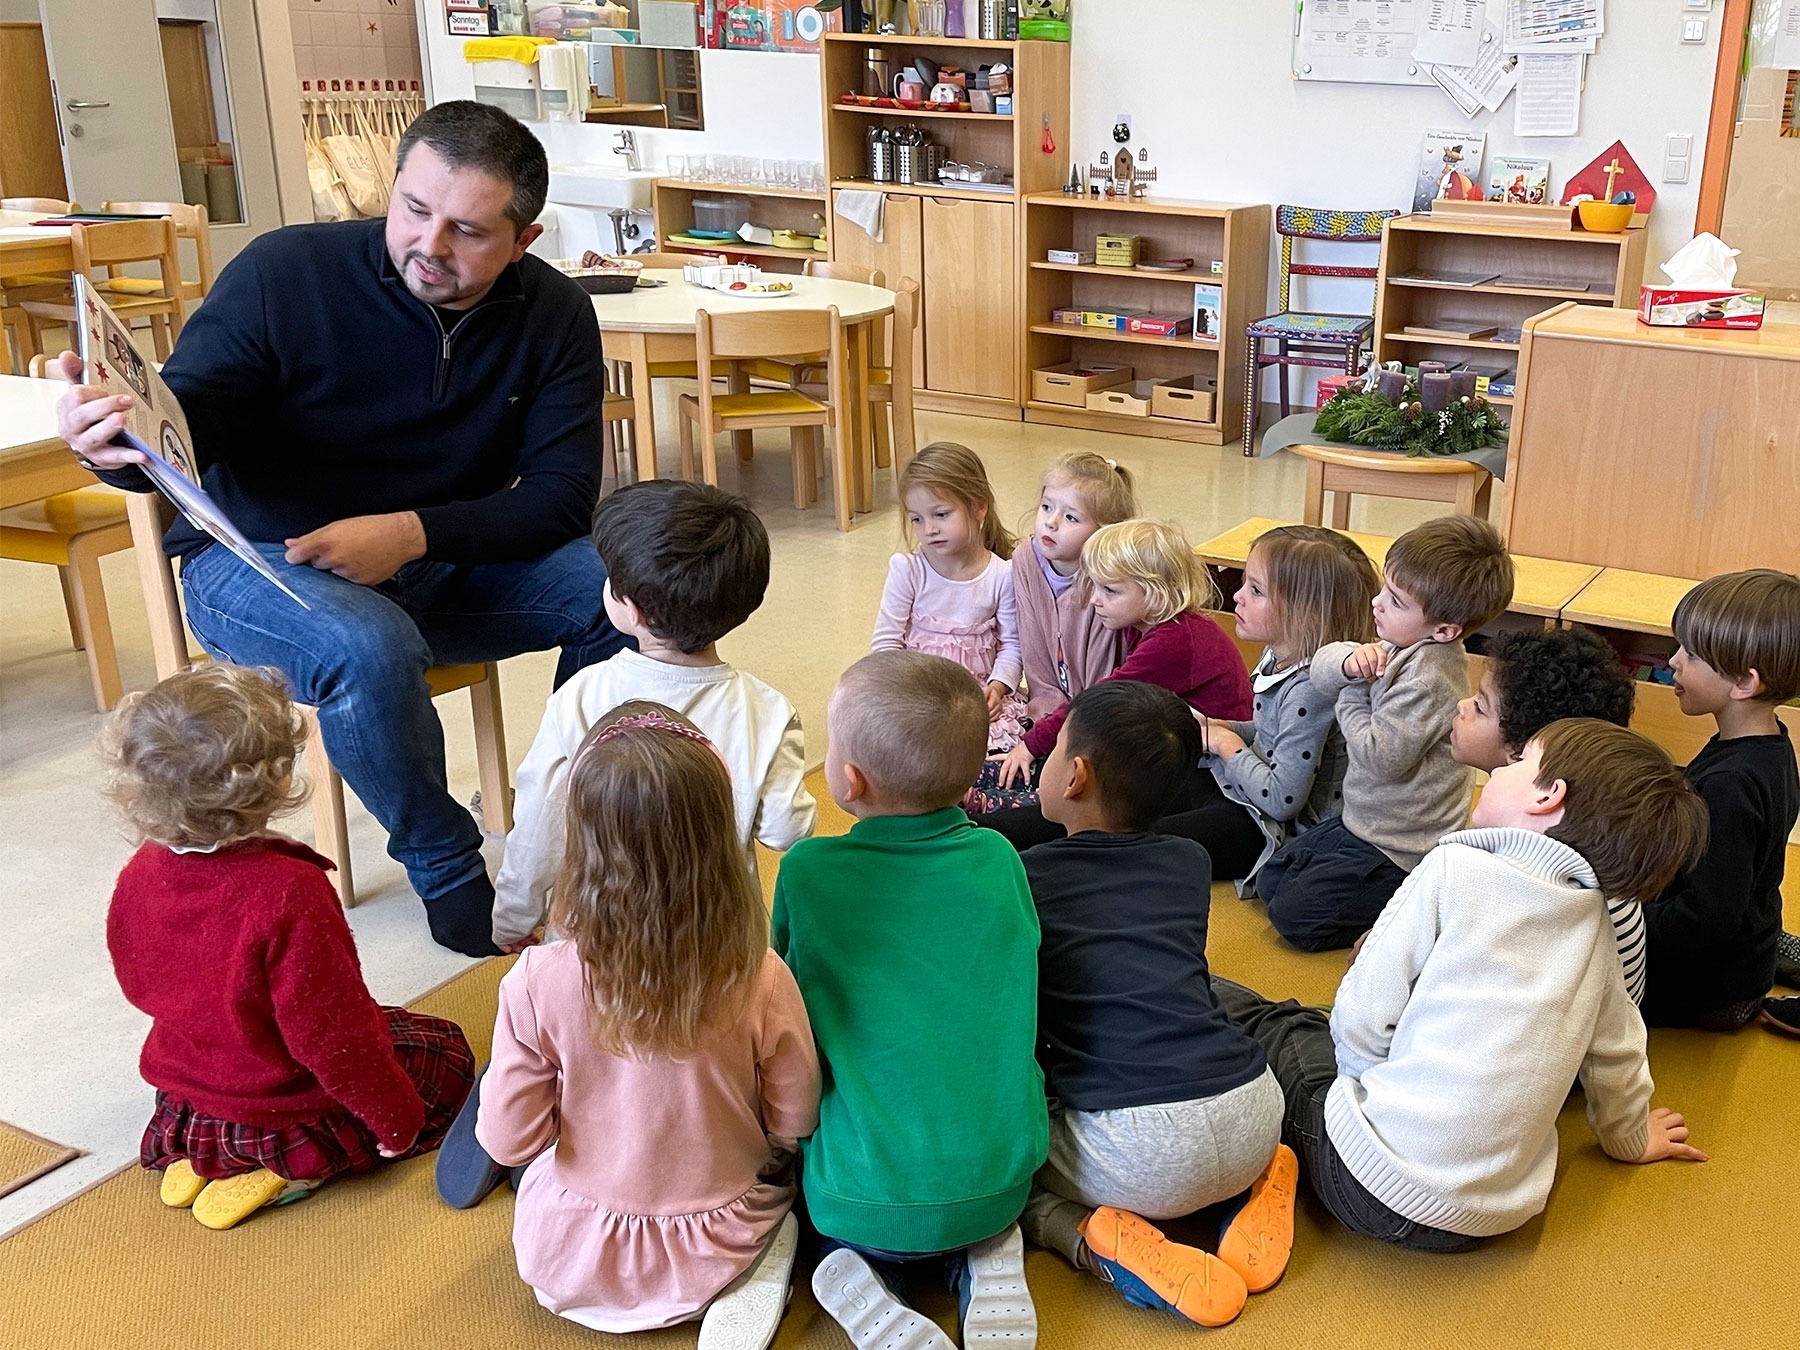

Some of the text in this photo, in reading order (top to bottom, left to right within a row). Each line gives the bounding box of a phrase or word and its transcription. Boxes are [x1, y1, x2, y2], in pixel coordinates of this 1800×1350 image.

[452, 15, 479, 26] Sonntag
[1507, 163, 1533, 171] Nikolaus
[1141, 323, 1165, 331] memory
